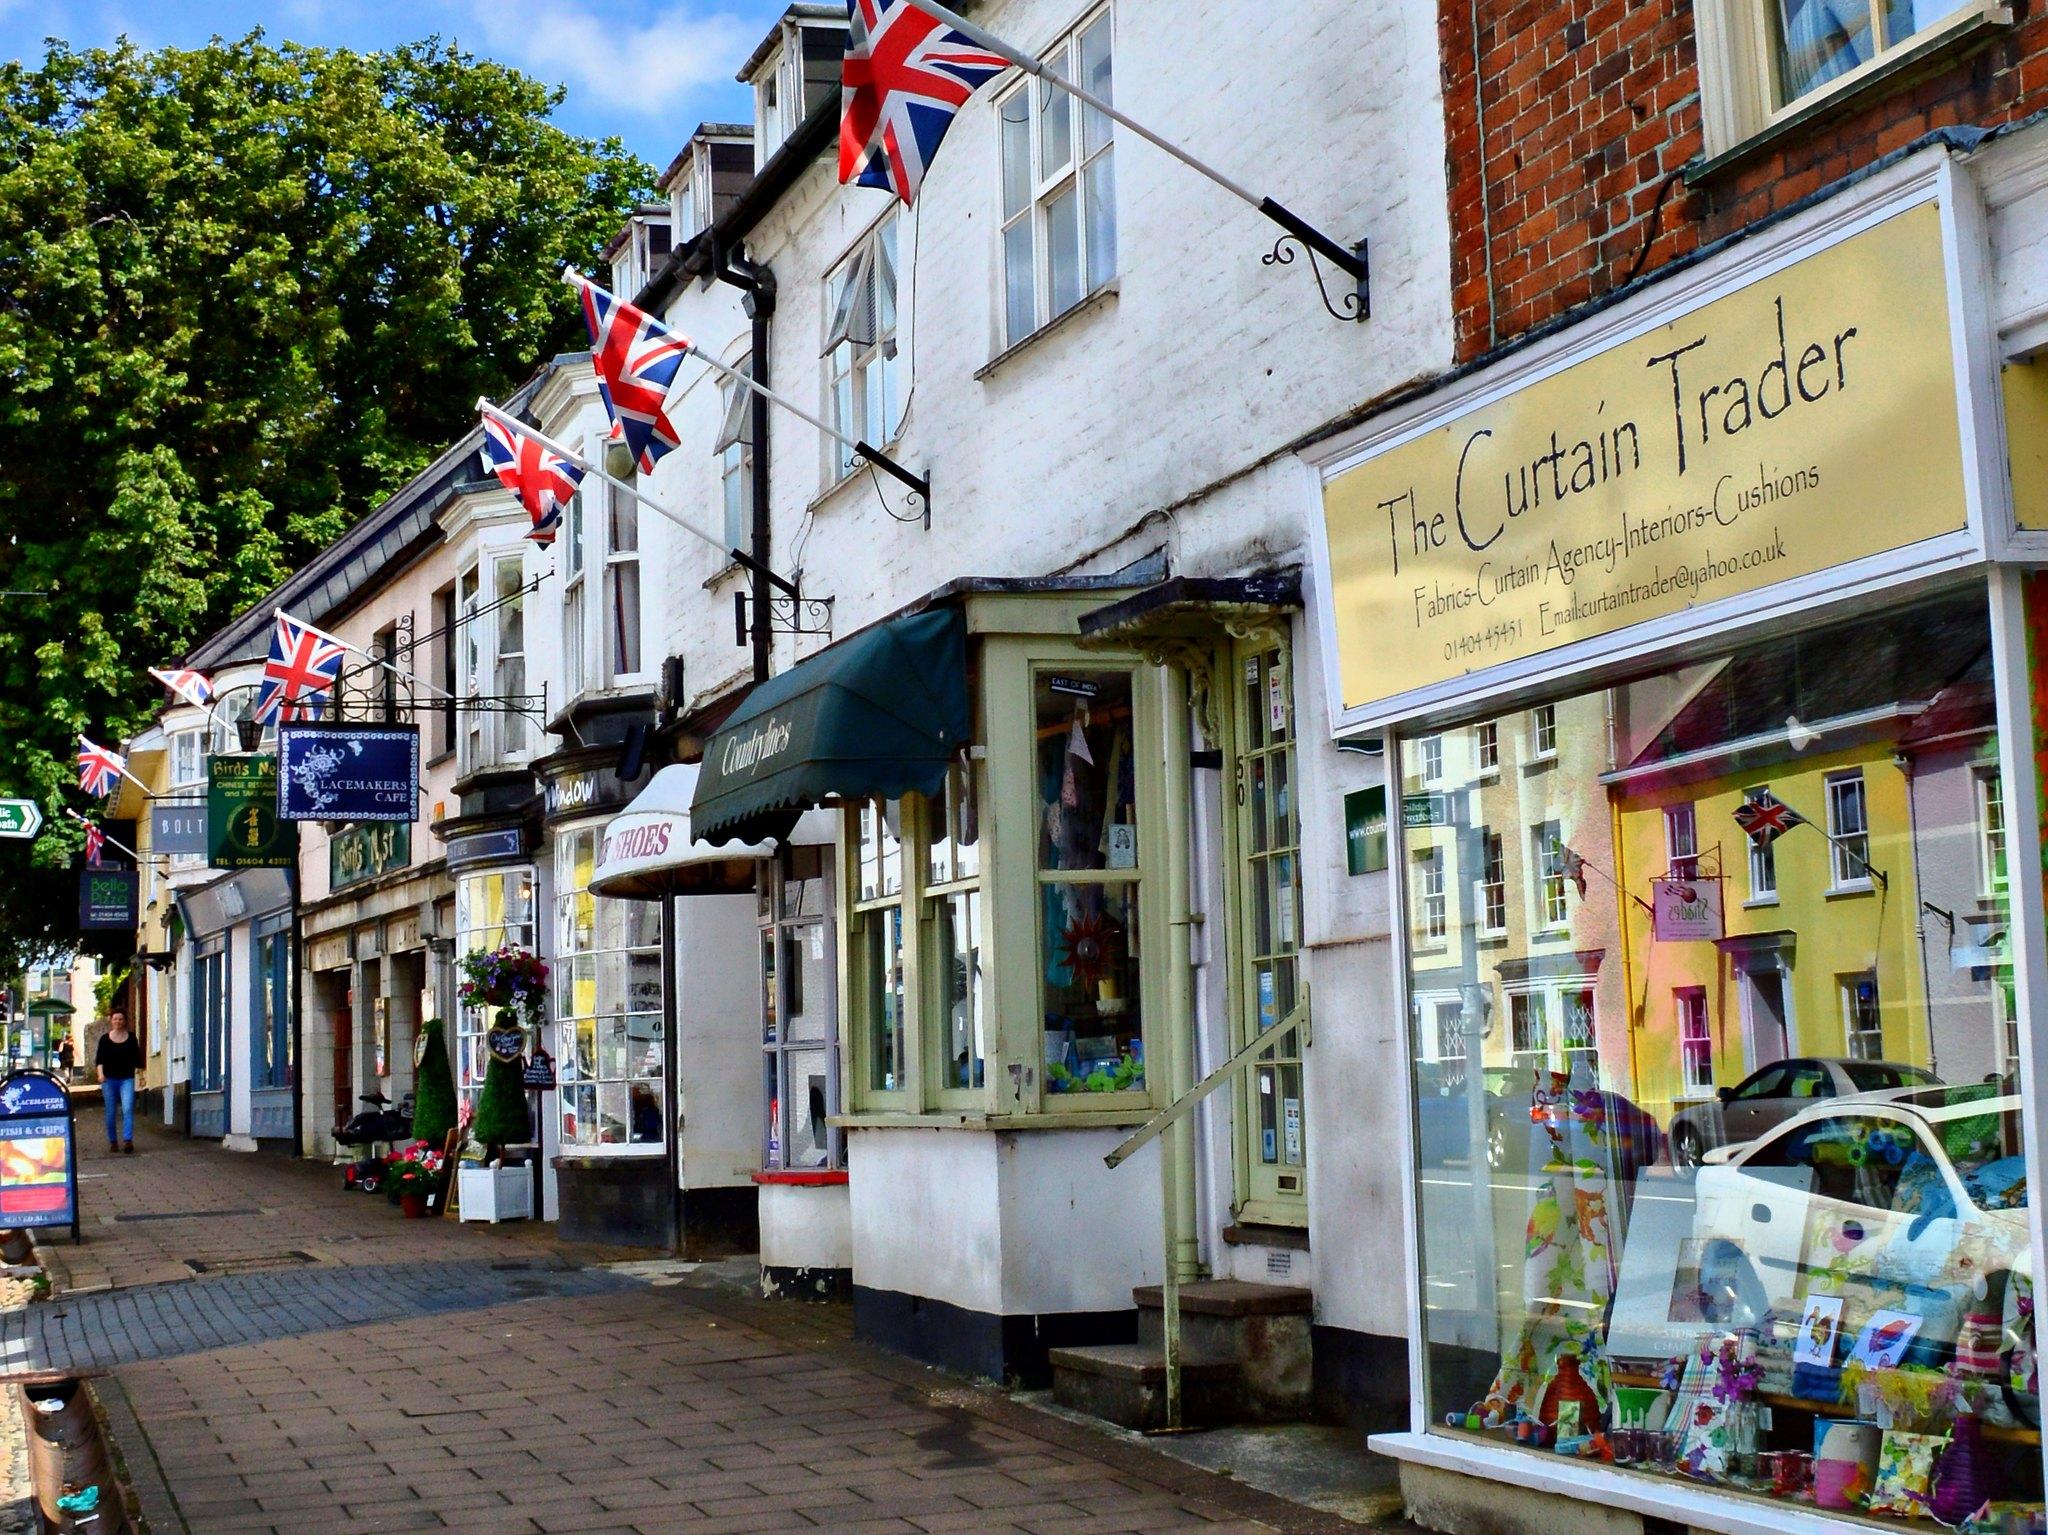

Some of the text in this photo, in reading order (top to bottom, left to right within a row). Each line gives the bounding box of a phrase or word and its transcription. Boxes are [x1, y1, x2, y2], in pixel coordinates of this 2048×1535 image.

[1377, 295, 1857, 577] The Curtain Trader
[258, 761, 277, 776] Ne
[320, 780, 407, 790] LACEMAKERS
[375, 792, 407, 803] CAFE
[615, 822, 673, 861] SHOES
[17, 1097, 64, 1106] LACEMAKERS
[34, 1125, 65, 1135] CHIPS
